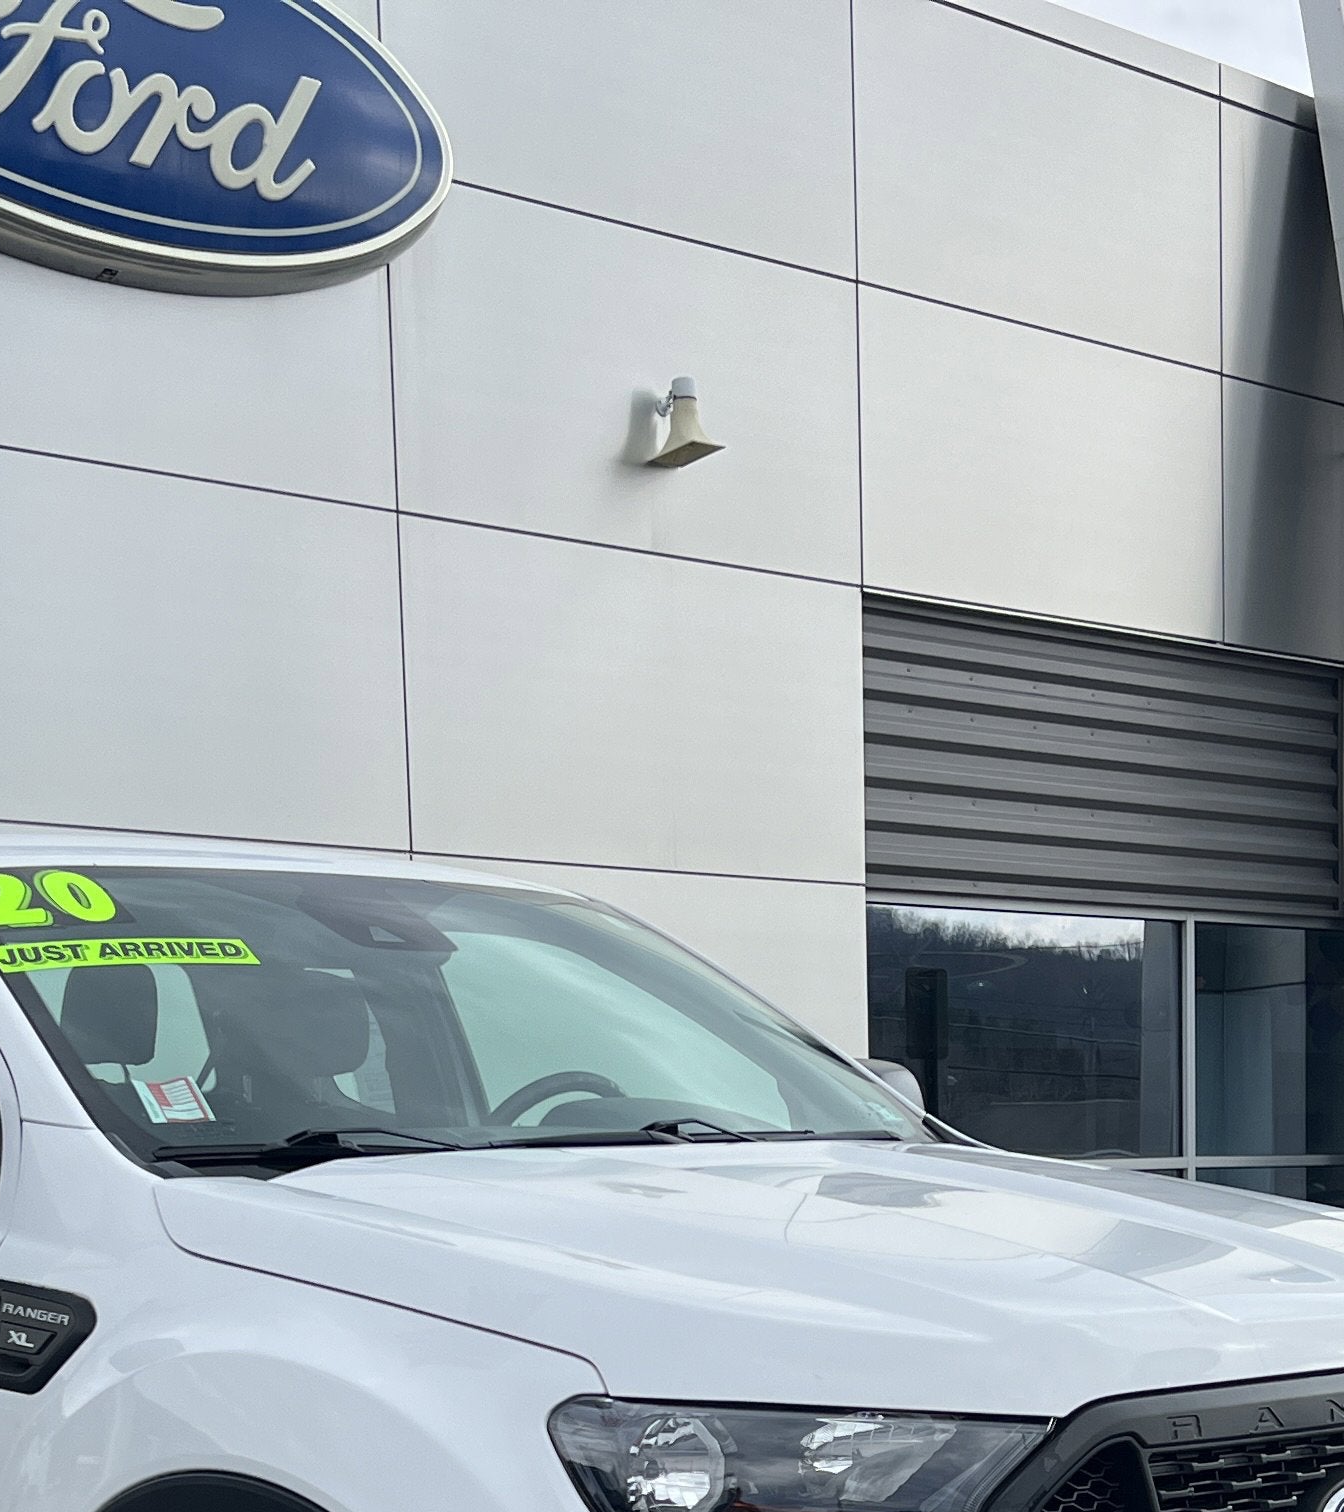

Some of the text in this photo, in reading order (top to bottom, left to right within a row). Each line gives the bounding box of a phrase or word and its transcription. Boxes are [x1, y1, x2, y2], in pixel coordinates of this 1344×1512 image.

[0, 941, 249, 968] JUST ARRIVED
[1, 1302, 70, 1326] RANGER
[7, 1330, 35, 1348] XL
